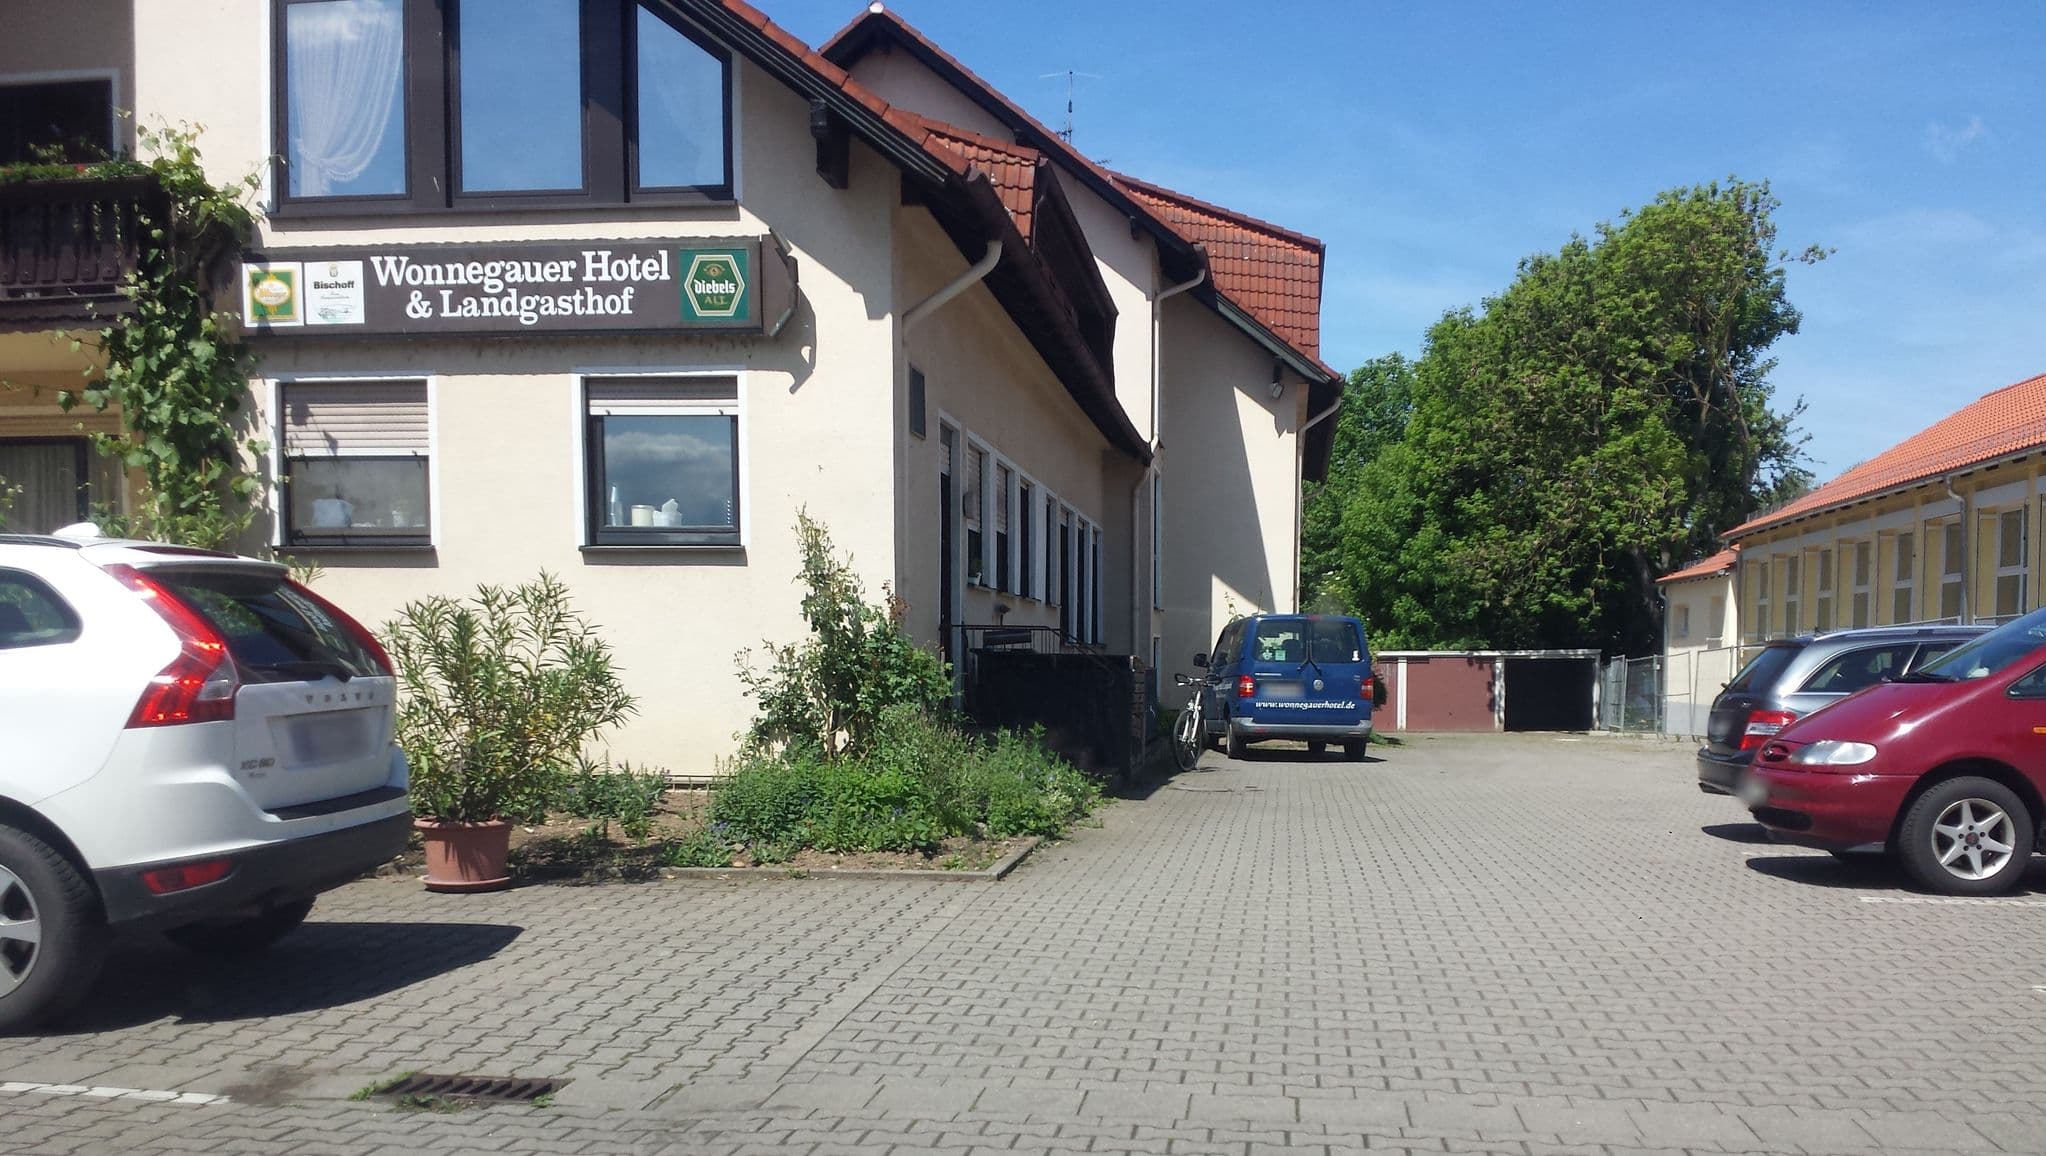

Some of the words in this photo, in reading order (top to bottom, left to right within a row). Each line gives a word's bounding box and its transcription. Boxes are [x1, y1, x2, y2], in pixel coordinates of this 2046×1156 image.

[370, 255, 576, 293] Wonnegauer
[582, 250, 671, 282] Hotel
[313, 280, 355, 290] Bischoff
[405, 289, 432, 319] &
[439, 286, 634, 325] Landgasthof
[1255, 700, 1356, 710] www.wonnegauerhotel.de
